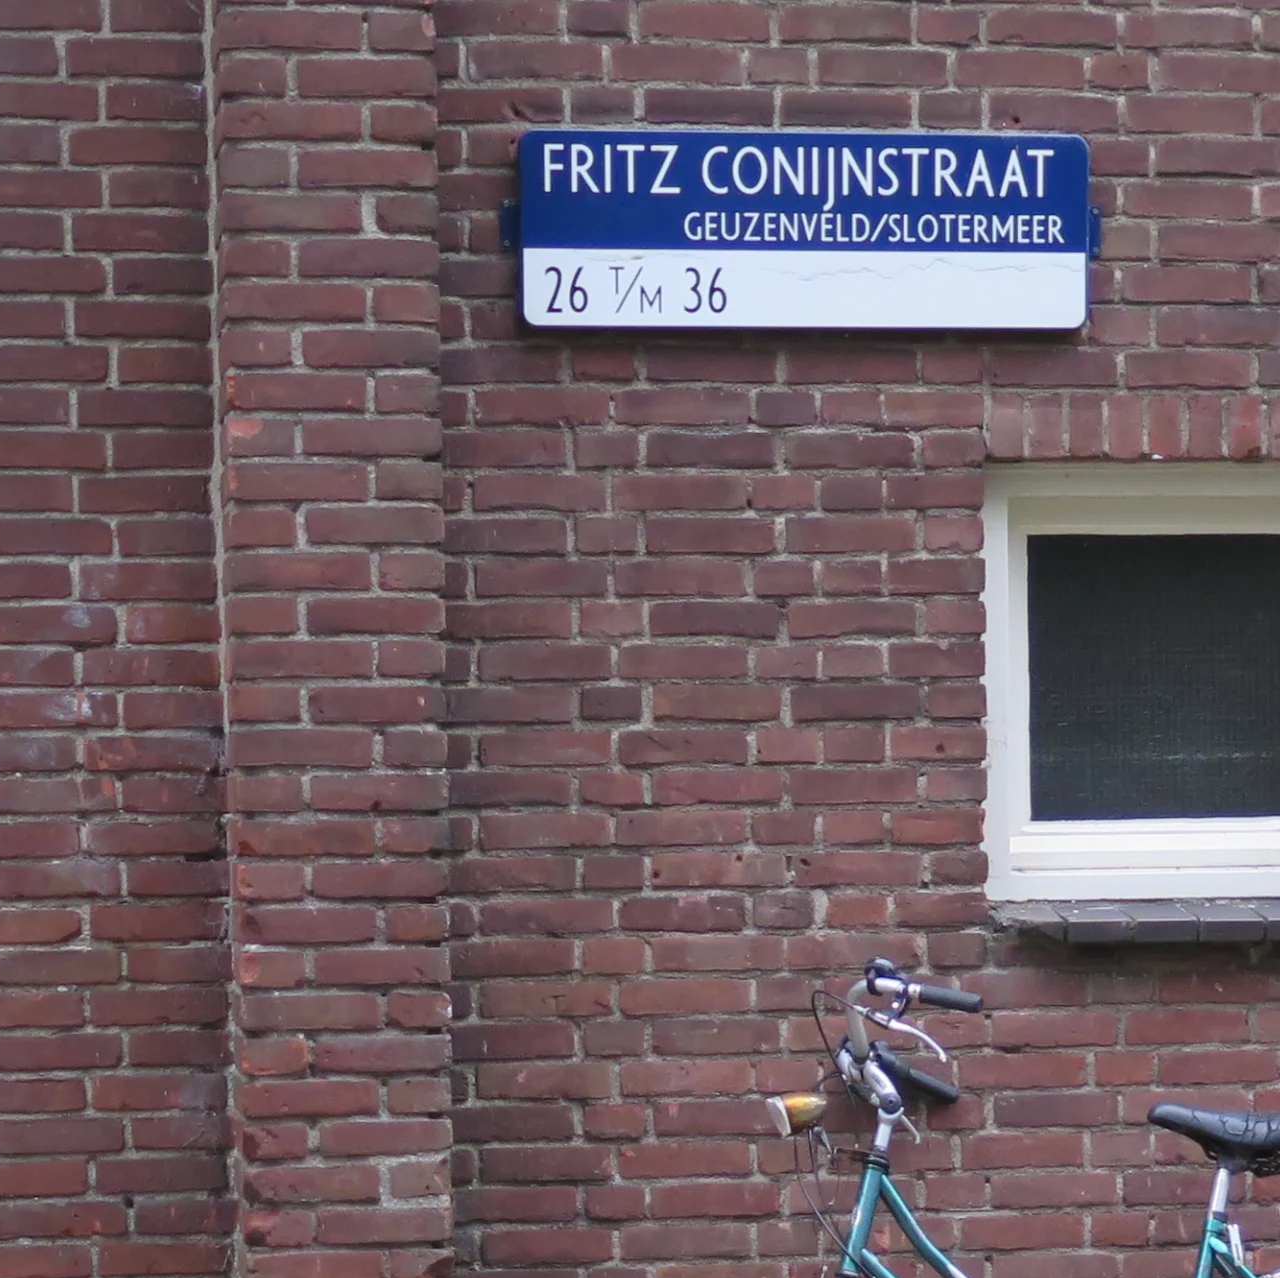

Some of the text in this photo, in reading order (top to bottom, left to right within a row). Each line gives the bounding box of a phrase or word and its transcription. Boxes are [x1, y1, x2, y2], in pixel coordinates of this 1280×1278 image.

[543, 143, 1056, 212] FRITZ CONIJNSTRAAT
[683, 211, 1067, 244] GEUZENVELD/SLOTERMEER
[544, 266, 728, 314] 26 T/M 36
